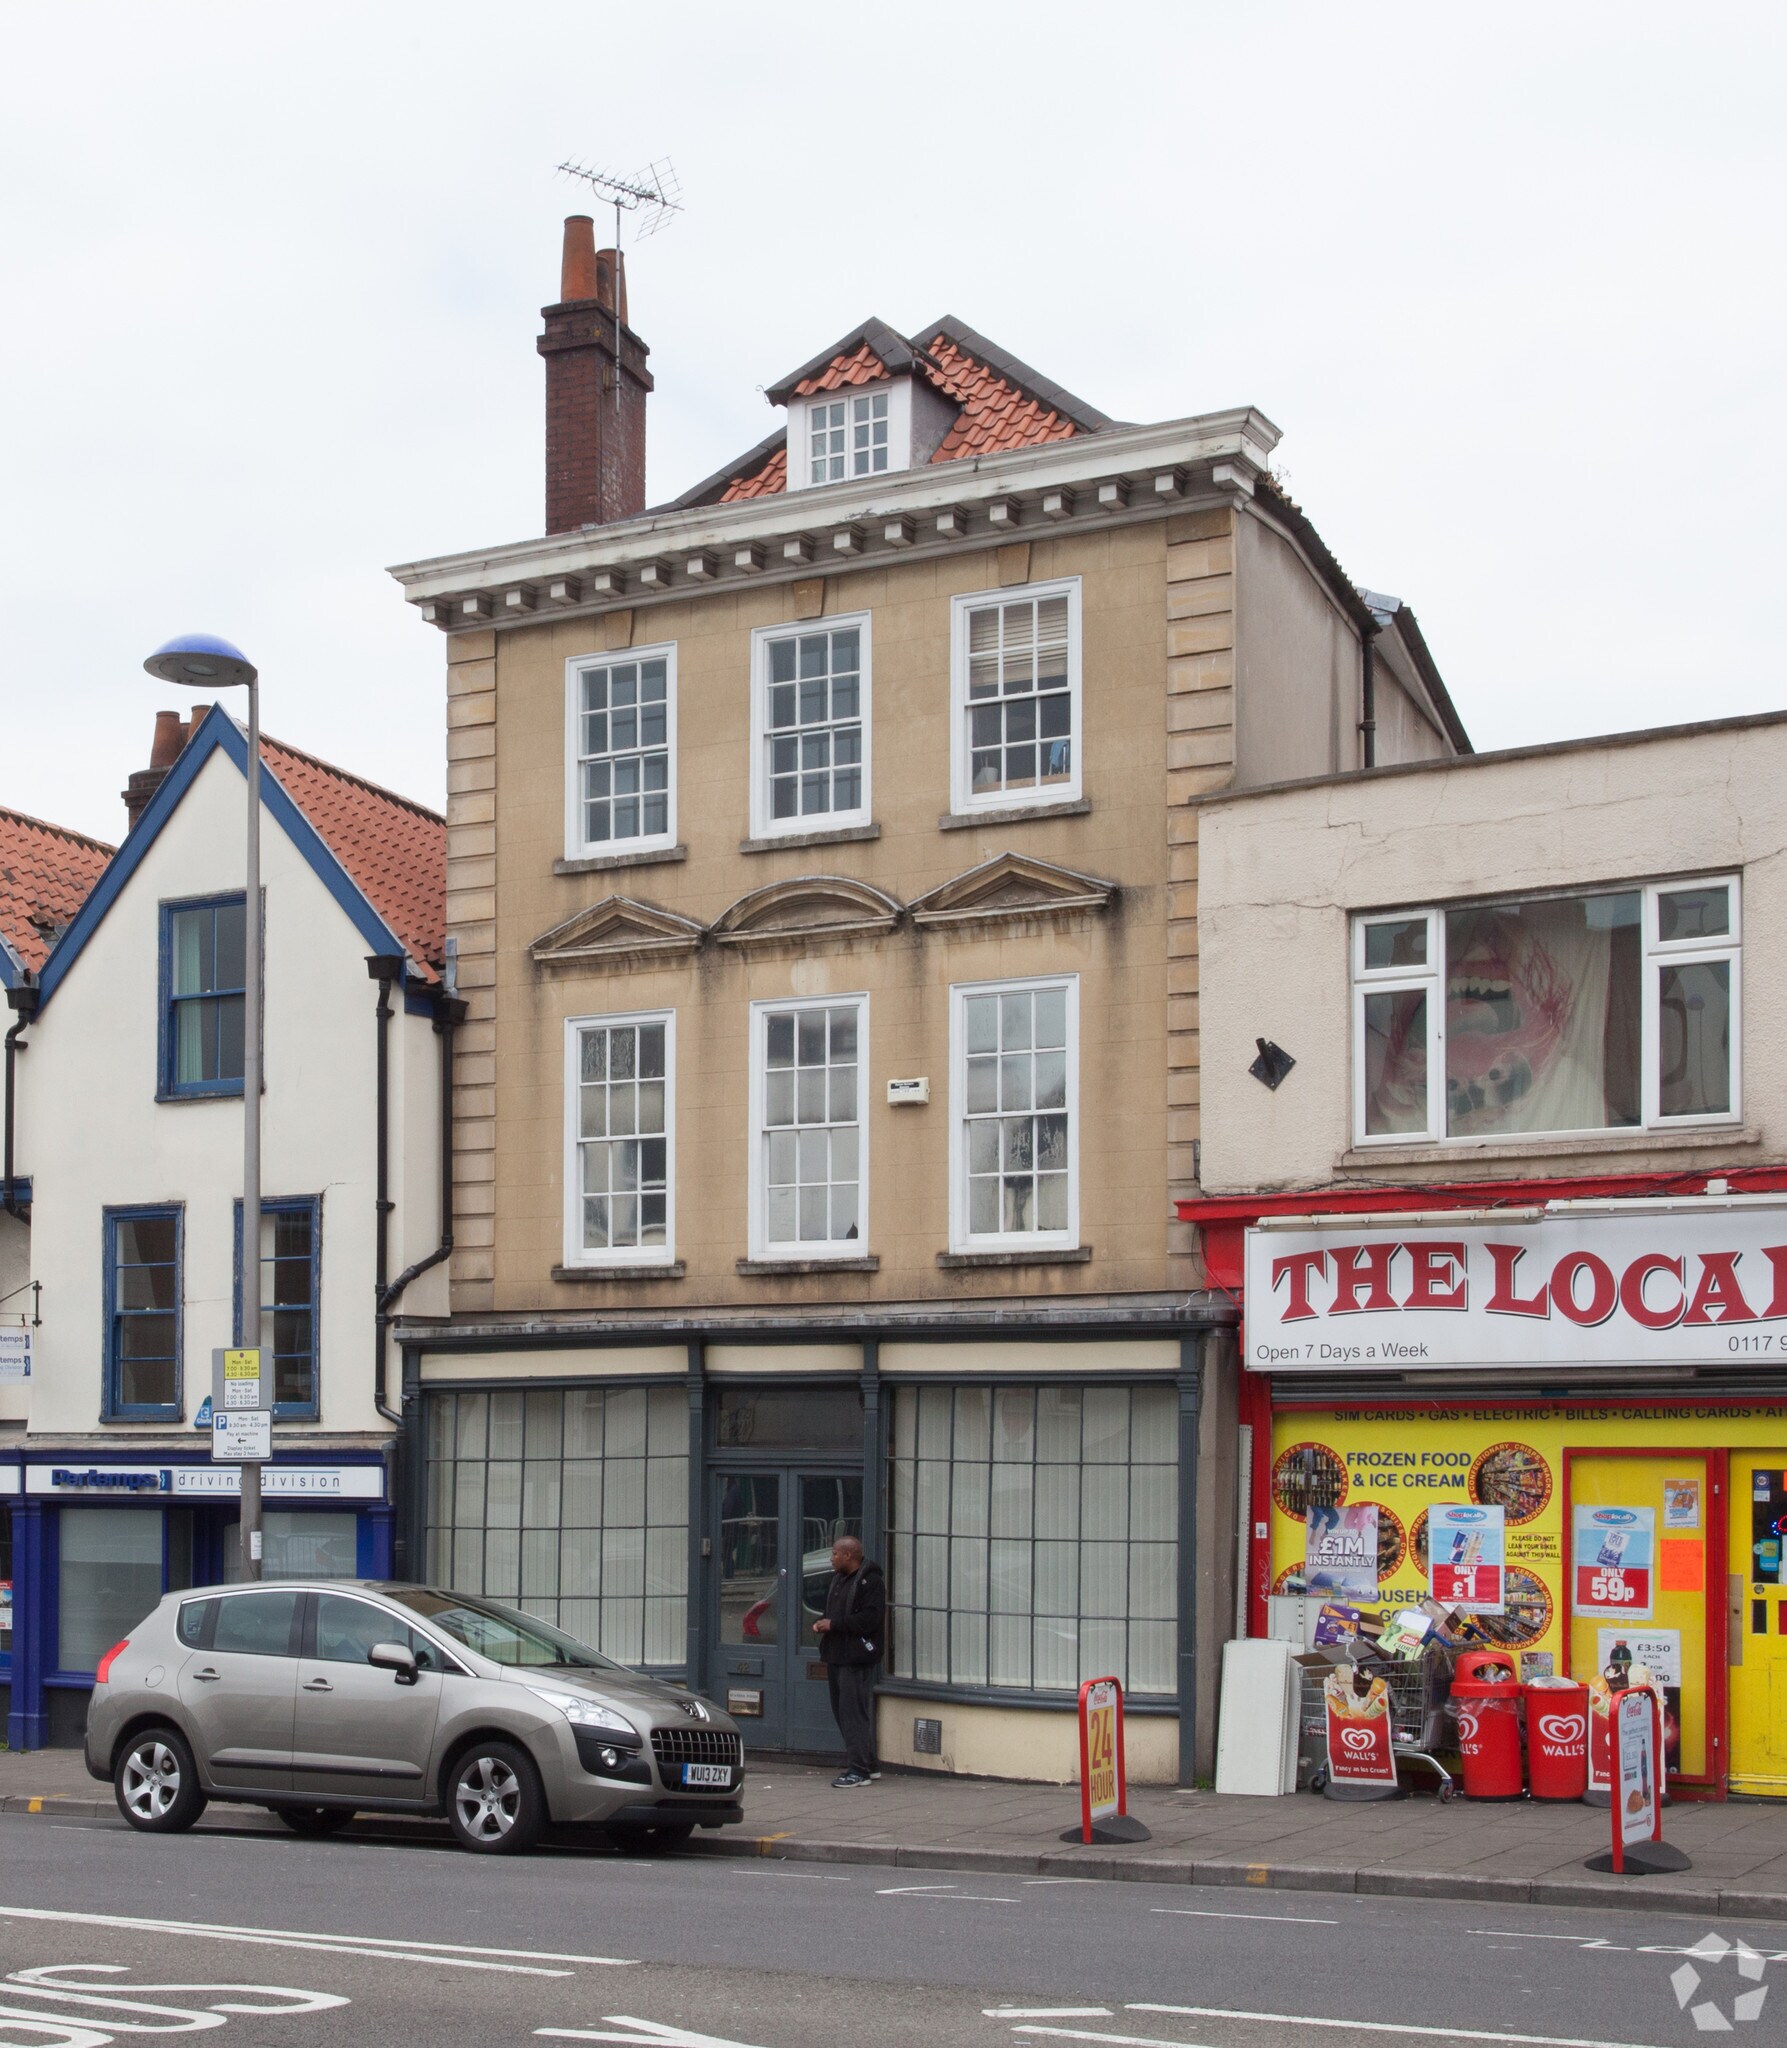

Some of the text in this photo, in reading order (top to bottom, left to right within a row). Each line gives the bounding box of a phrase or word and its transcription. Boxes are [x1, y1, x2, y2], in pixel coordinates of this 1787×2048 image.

[1271, 1241, 1468, 1324] THE
[1728, 1335, 1773, 1351] 0117
[1256, 1342, 1429, 1363] Open 7 Days a Week
[217, 1416, 226, 1429] P
[1346, 1452, 1471, 1467] FROZEN FOOD
[51, 1469, 156, 1491] Pertemps
[260, 1474, 340, 1489] division
[1352, 1473, 1465, 1488] & ICE CREAM
[1318, 1536, 1364, 1556] £1M
[1309, 1555, 1376, 1567] INSTANTLY
[1453, 1565, 1478, 1575] ONLY
[1600, 1567, 1626, 1578] ONLY
[1452, 1574, 1476, 1598] £1
[1591, 1576, 1635, 1602] 59p
[1637, 1643, 1671, 1653] £3:50
[1090, 1708, 1112, 1770] 24
[1343, 1750, 1377, 1761] WALL'S
[1460, 1743, 1479, 1755] LL'S
[1542, 1744, 1585, 1756] WALL'S
[690, 1766, 729, 1783] WU13 ZXY
[1335, 1765, 1352, 1774] Fancy
[1370, 1767, 1389, 1775] Cream?
[1090, 1769, 1115, 1804] HOUR
